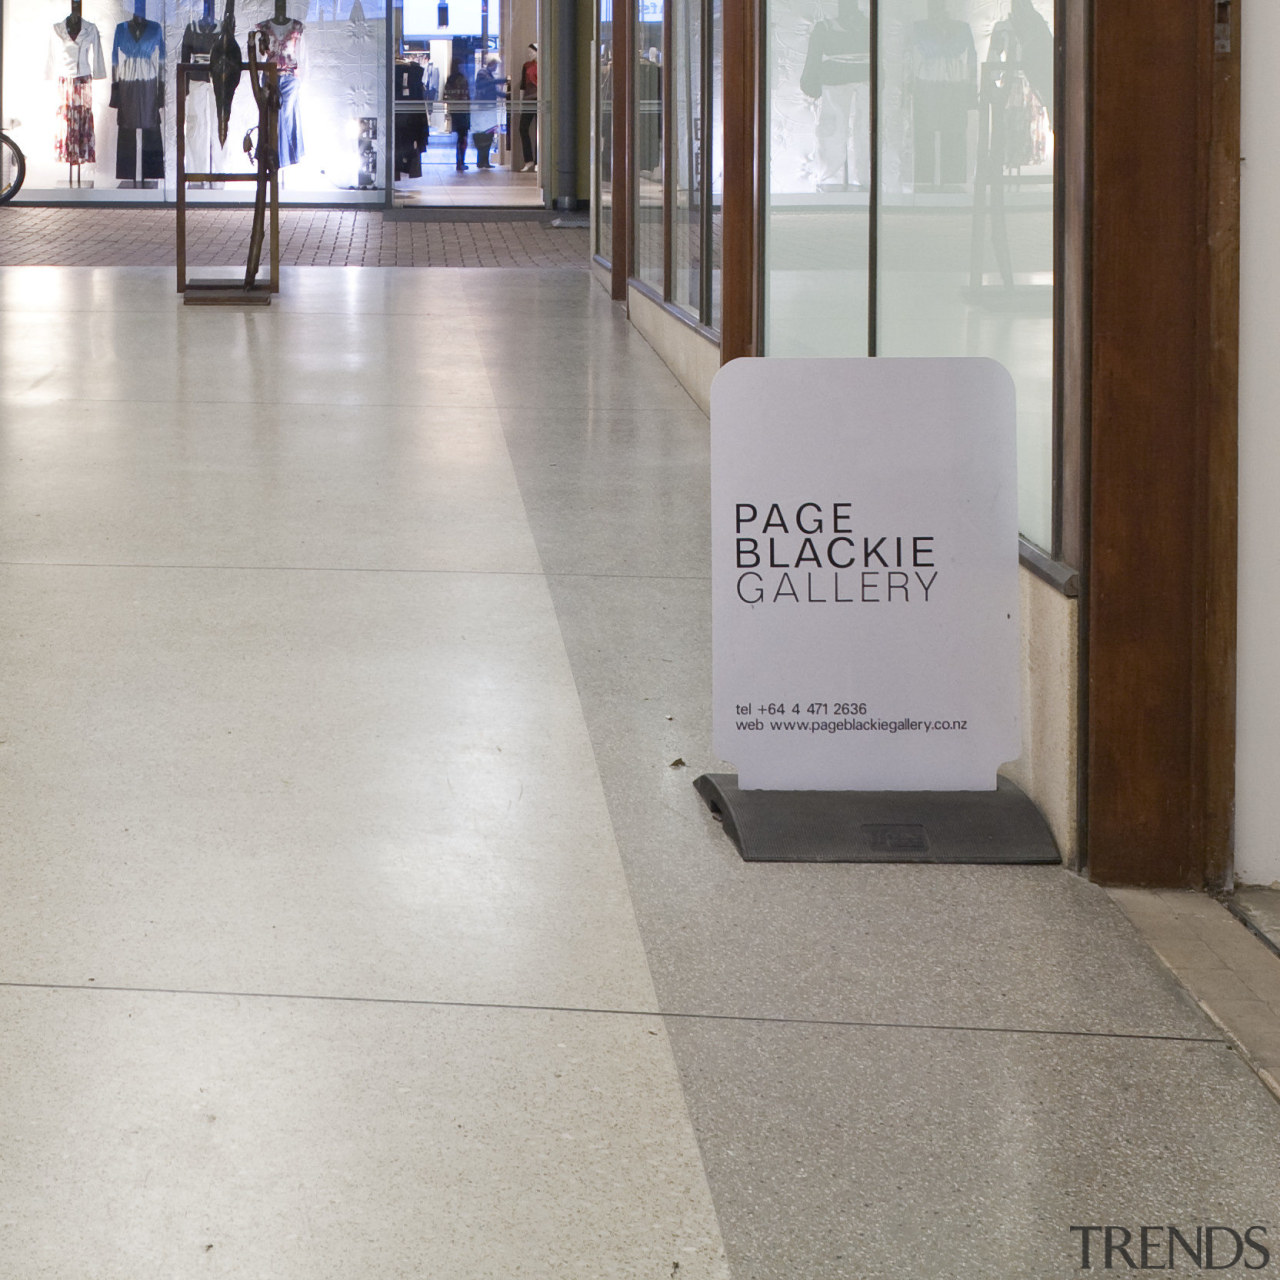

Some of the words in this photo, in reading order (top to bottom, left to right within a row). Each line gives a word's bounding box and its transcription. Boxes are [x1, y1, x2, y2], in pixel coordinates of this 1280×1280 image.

[735, 502, 853, 534] PAGE
[735, 537, 936, 569] BLACKIE
[735, 571, 939, 604] GALLERY
[735, 703, 752, 715] tel
[757, 703, 785, 715] +64
[791, 703, 801, 715] 4
[806, 703, 829, 715] 471
[833, 703, 867, 715] 2636
[735, 719, 764, 731] web
[769, 718, 968, 734] www.pageblackiegallery.co.nz
